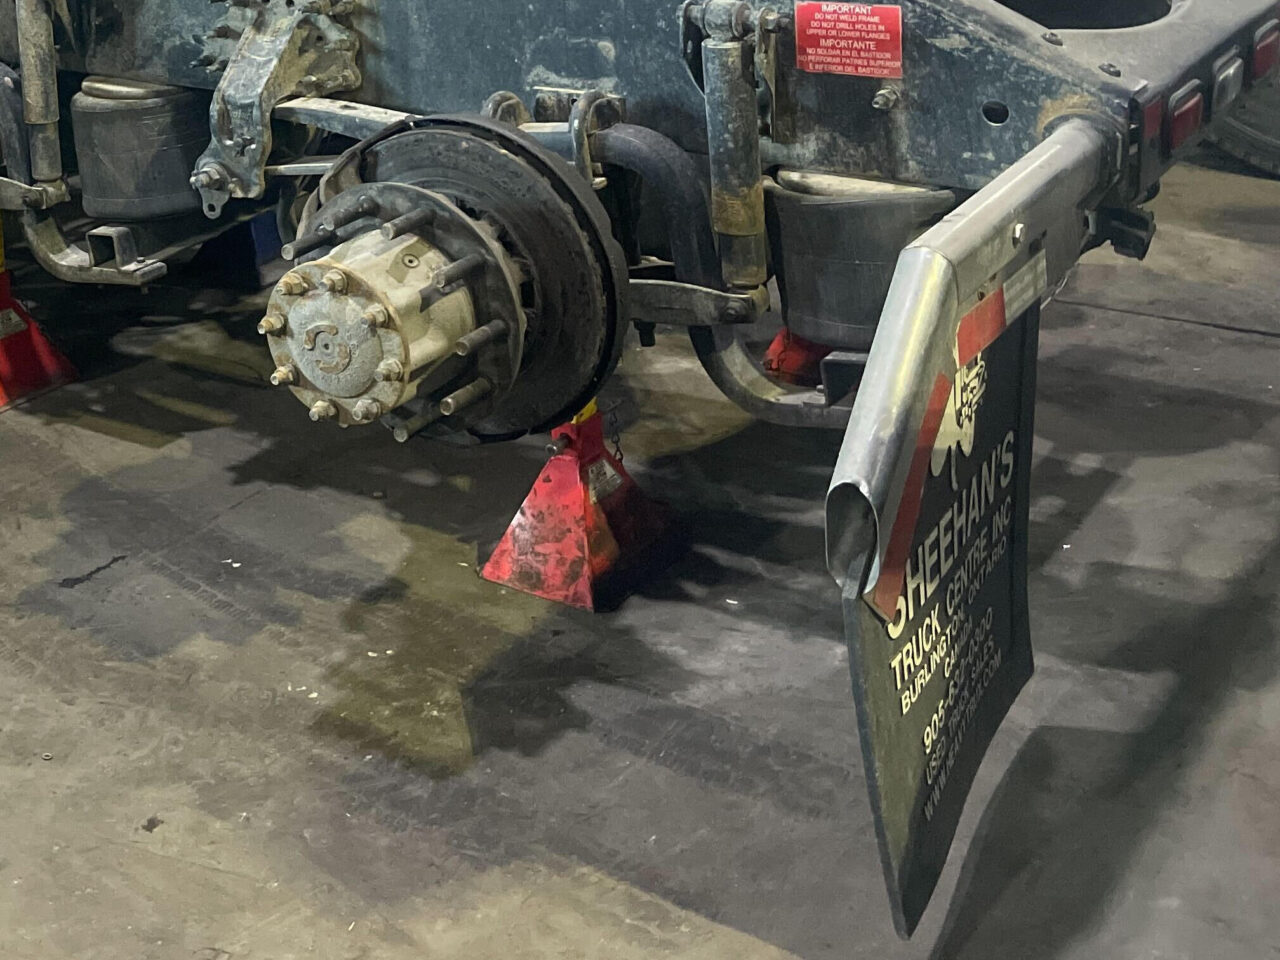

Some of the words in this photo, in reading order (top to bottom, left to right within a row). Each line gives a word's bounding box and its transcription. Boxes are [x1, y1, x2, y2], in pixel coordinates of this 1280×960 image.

[821, 4, 873, 14] IMPORTANT
[814, 12, 824, 20] DO
[840, 14, 858, 22] WELD
[836, 22, 854, 30] DRILL
[806, 28, 826, 36] UPPER
[838, 30, 860, 38] LOWER
[861, 32, 890, 40] FLANGES
[820, 39, 876, 50] IMPORTANTE
[816, 48, 840, 56] SOLDAR
[852, 50, 860, 58] EL
[860, 51, 891, 59] BASTIDOR
[869, 59, 902, 67] SUPERIOR
[858, 66, 890, 75] BASTIDOR
[890, 602, 942, 690] TRUCK
[946, 526, 988, 616] CENTRE
[992, 495, 1012, 539] INC
[901, 605, 966, 716] BURLINGTON
[968, 536, 1007, 605] ONTARIO
[944, 615, 974, 679] CANADA
[926, 735, 946, 785] USED
[948, 680, 970, 738] TRUCK
[971, 634, 995, 687] SALES
